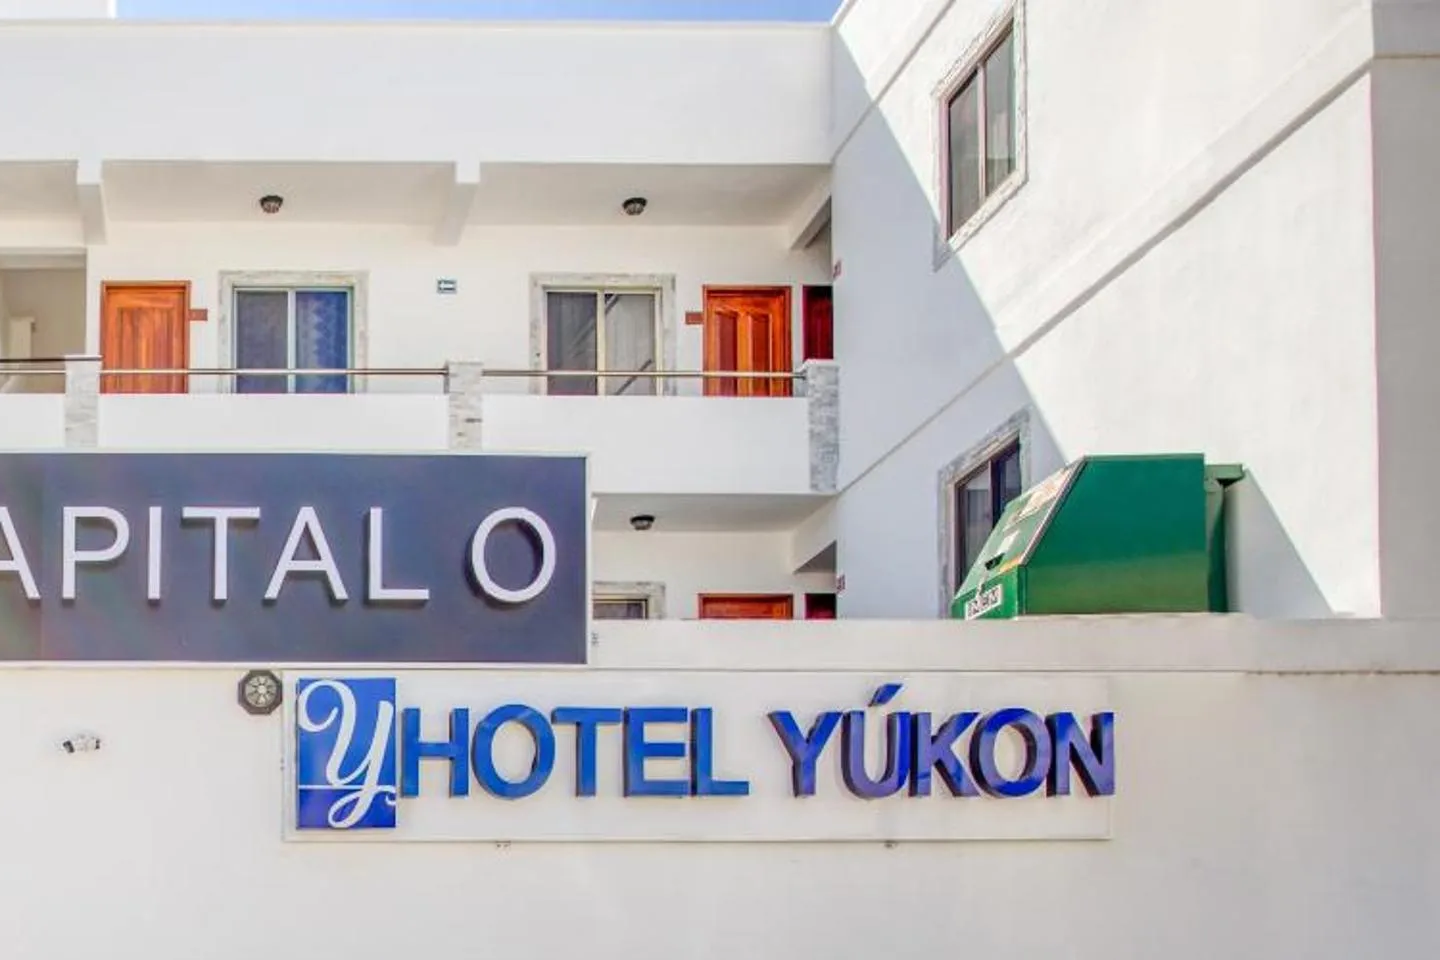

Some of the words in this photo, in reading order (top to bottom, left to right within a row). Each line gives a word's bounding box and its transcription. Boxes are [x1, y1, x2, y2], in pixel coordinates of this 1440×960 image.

[467, 506, 558, 602] O
[401, 704, 749, 799] HOTEL
[767, 684, 1115, 799] YÚKON
